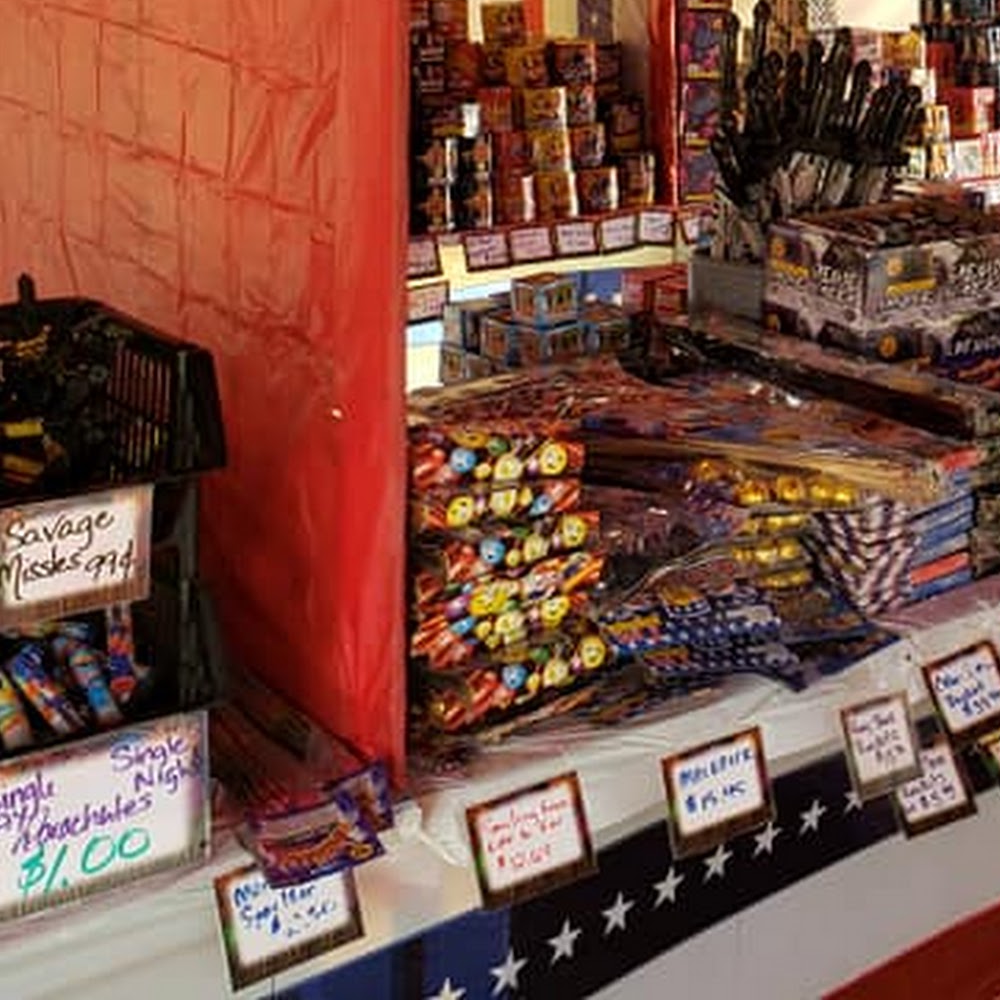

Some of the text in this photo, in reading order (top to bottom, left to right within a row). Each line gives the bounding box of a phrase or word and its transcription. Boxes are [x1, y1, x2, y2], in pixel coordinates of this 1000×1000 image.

[6, 510, 115, 551] Savage
[110, 736, 186, 772] Single
[18, 827, 151, 896] $1.00
